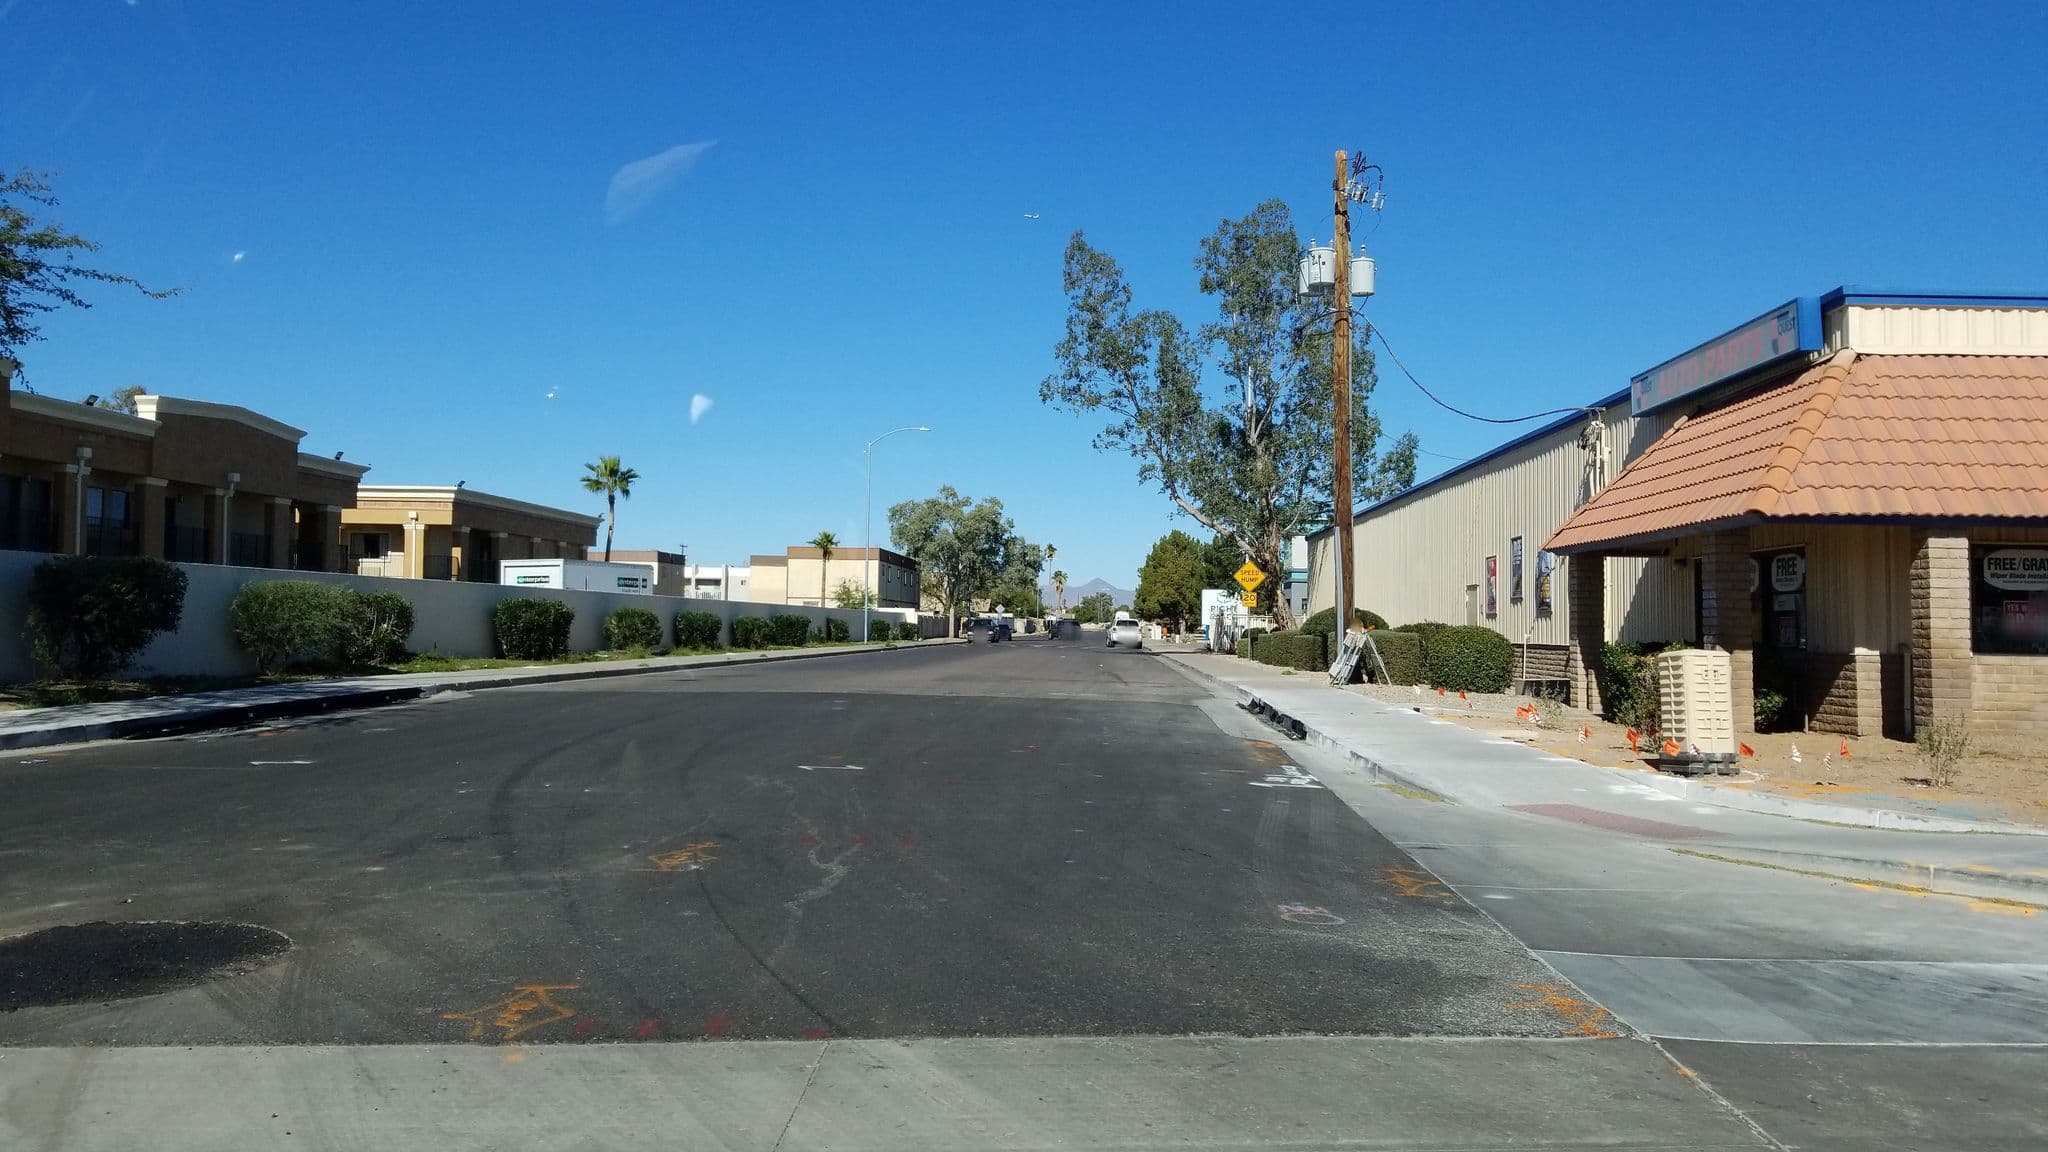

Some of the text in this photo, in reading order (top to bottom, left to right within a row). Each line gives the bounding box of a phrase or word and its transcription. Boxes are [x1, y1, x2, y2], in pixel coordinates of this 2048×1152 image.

[1657, 356, 1699, 396] AUTO
[1704, 328, 1764, 379] PARTS
[1776, 558, 1798, 576] FREE
[1987, 557, 2048, 571] FREE/GRA
